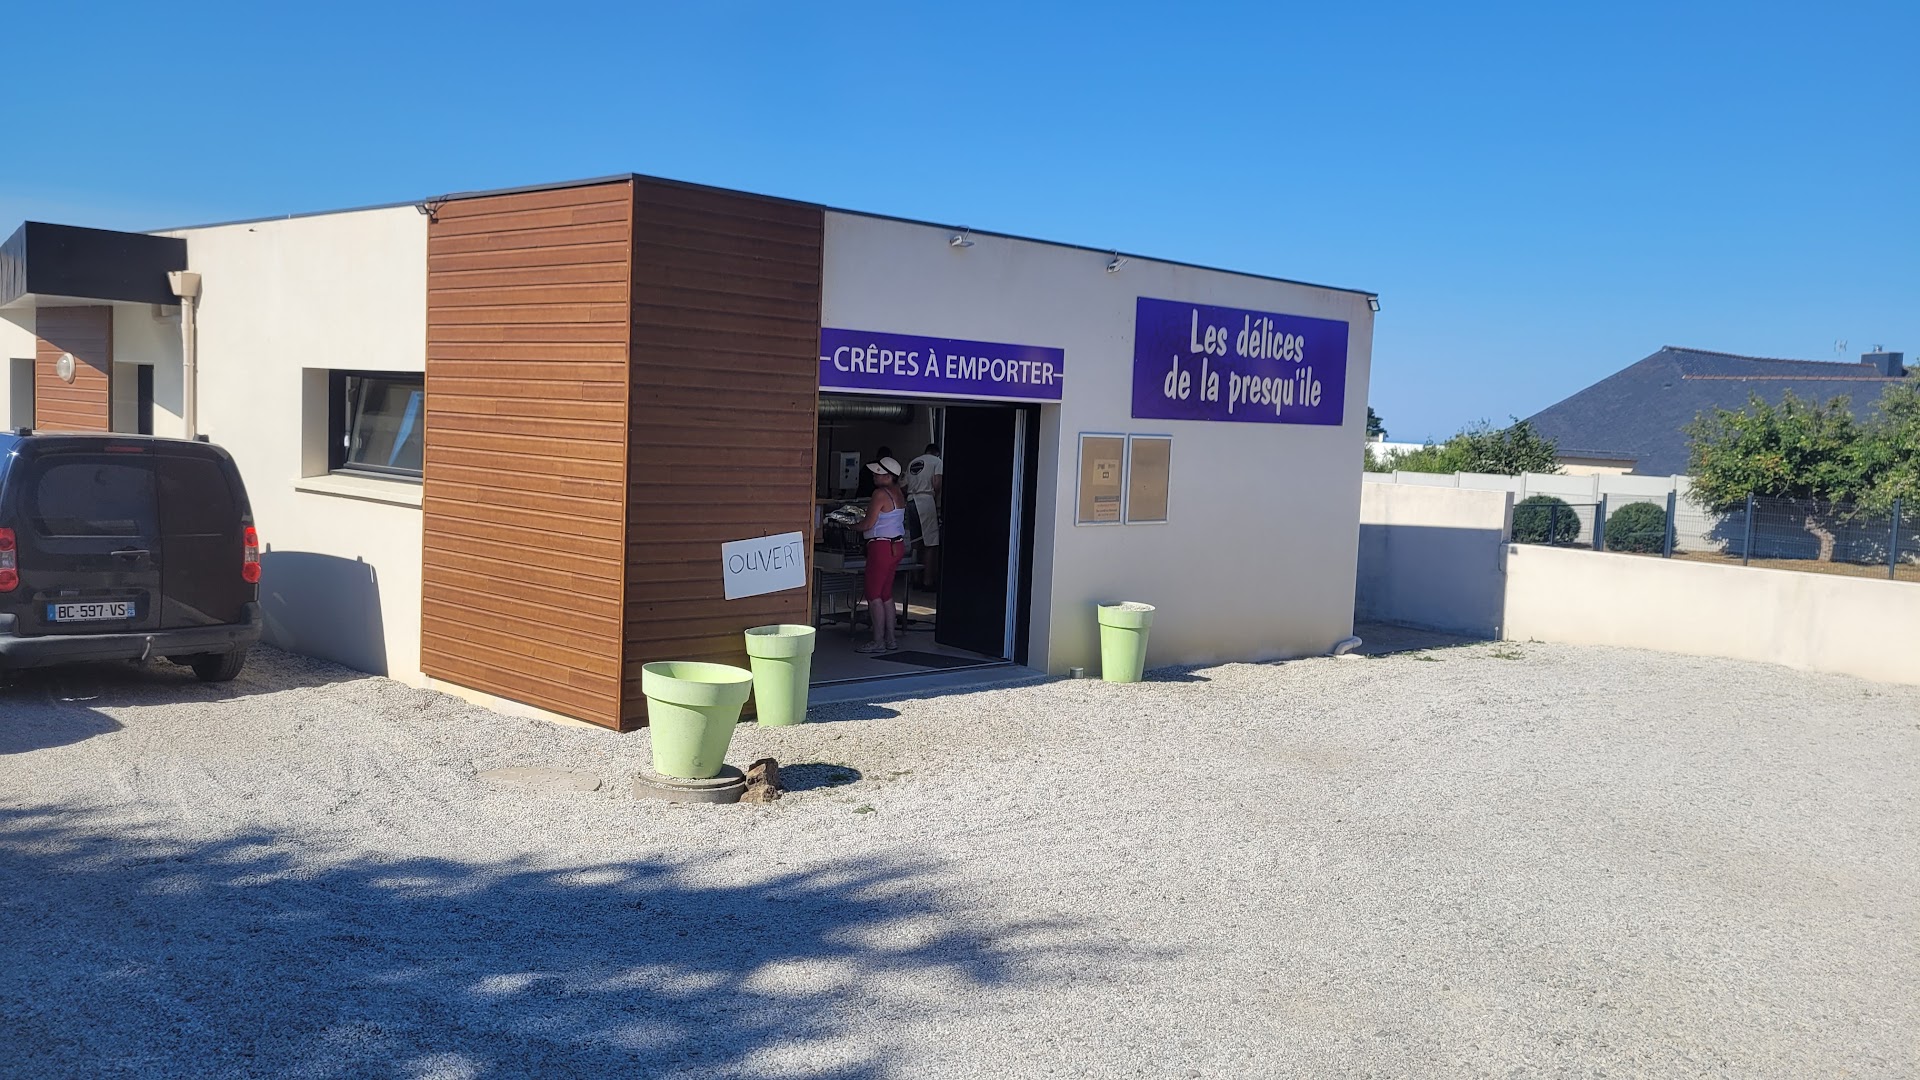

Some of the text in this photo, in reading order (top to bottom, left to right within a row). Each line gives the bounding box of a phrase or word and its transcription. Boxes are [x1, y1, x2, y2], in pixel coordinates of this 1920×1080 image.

[1190, 308, 1305, 363] Les délices
[924, 348, 940, 378] À
[1163, 354, 1322, 416] de la presqu'ile
[728, 541, 802, 574] OUVERT
